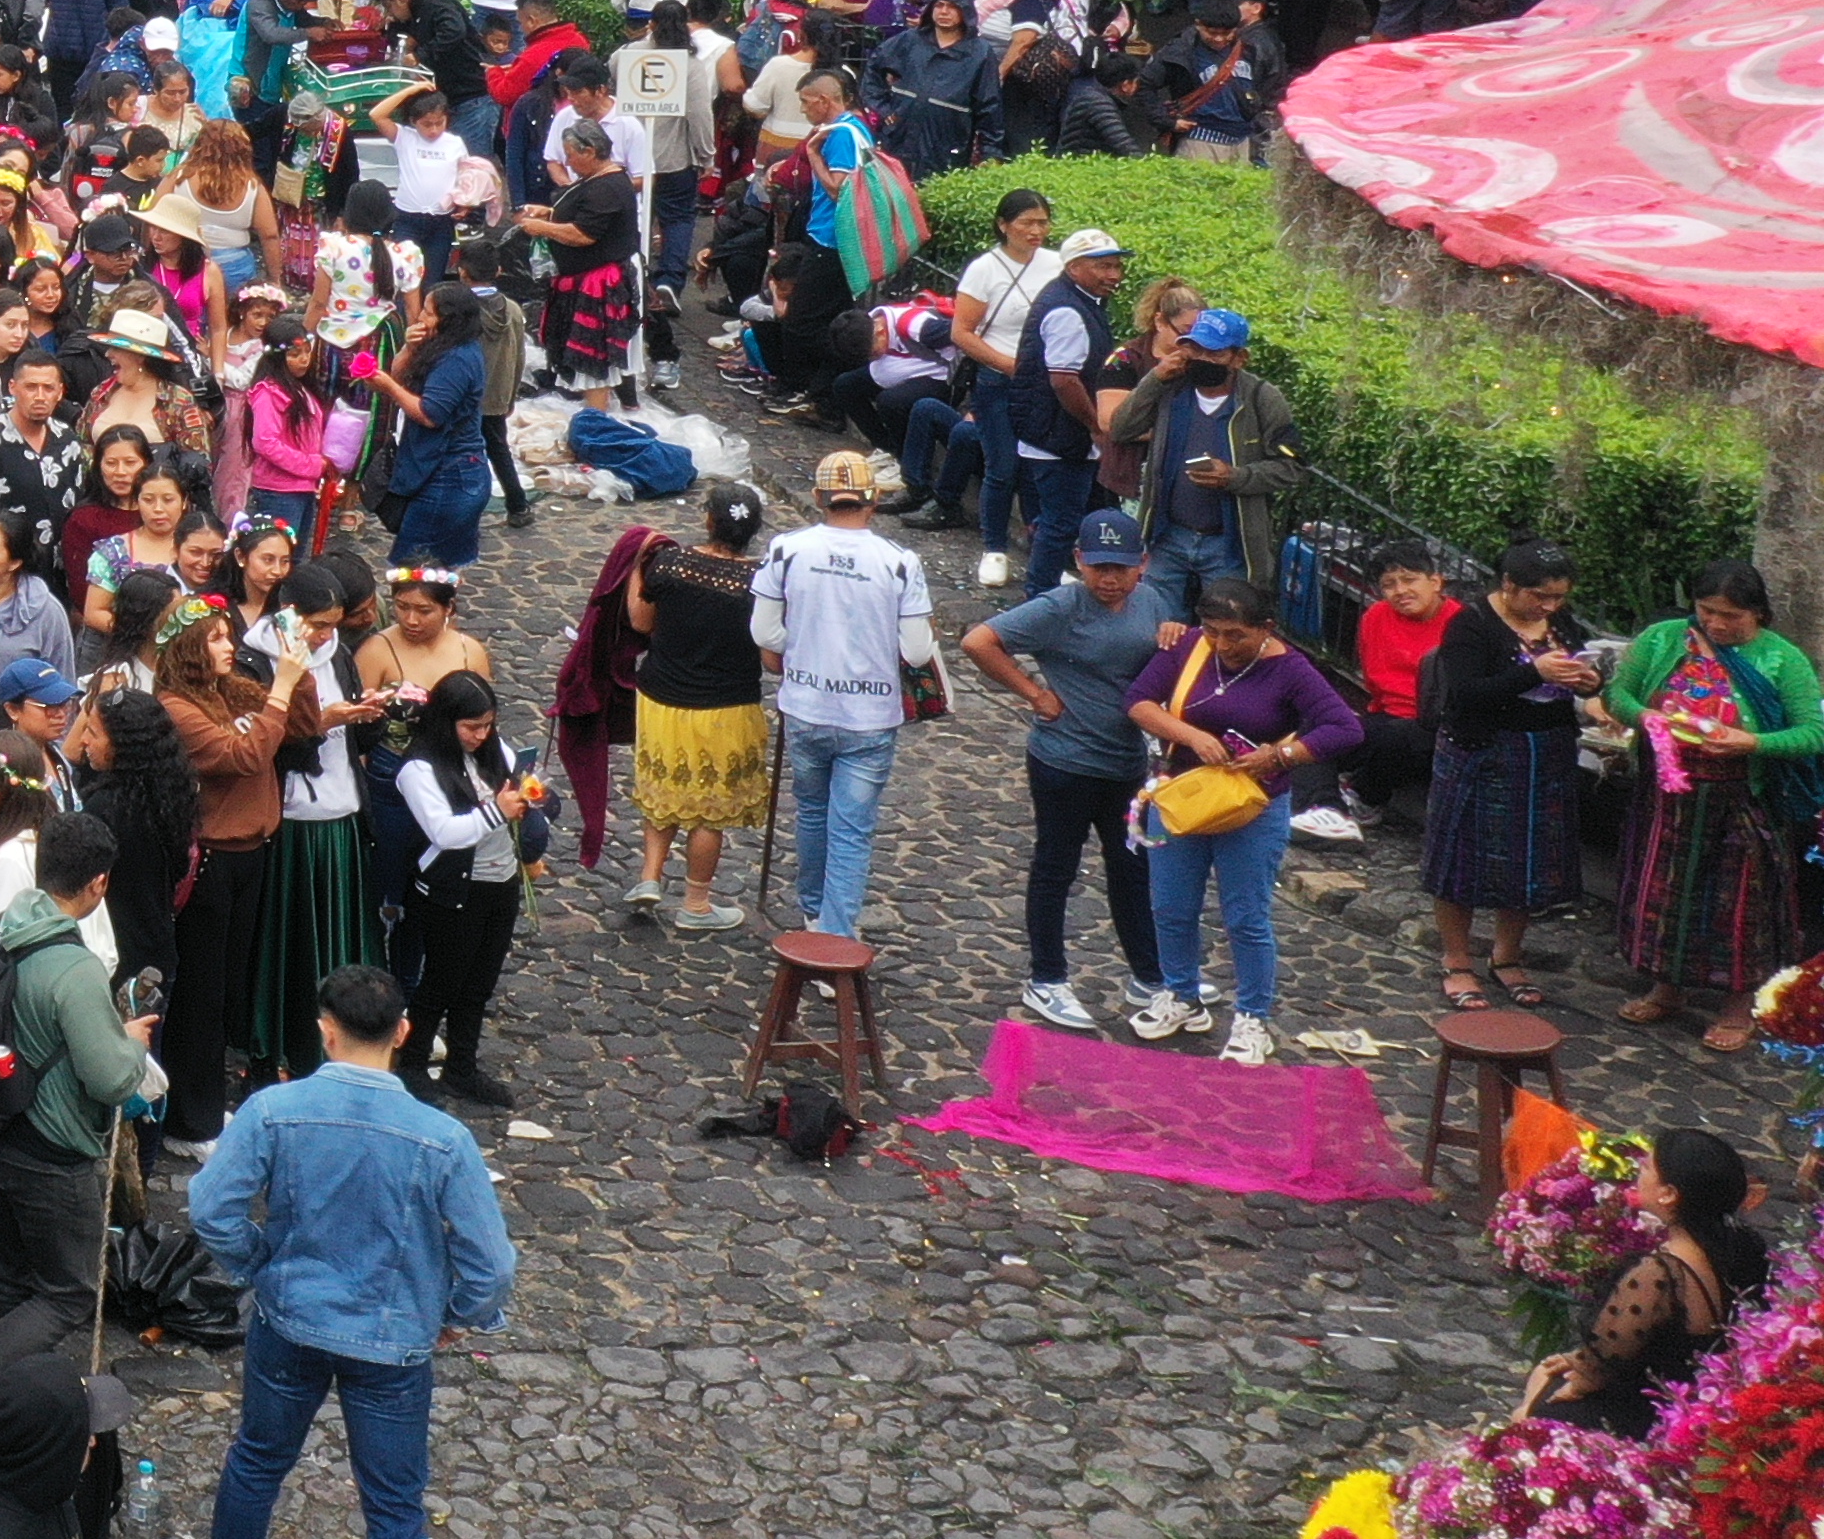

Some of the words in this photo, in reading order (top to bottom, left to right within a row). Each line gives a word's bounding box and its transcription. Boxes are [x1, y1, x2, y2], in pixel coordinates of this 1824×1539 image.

[622, 102, 634, 114] EN
[636, 102, 656, 114] ESTA
[786, 667, 822, 691] REAL
[823, 678, 893, 698] MADRID
